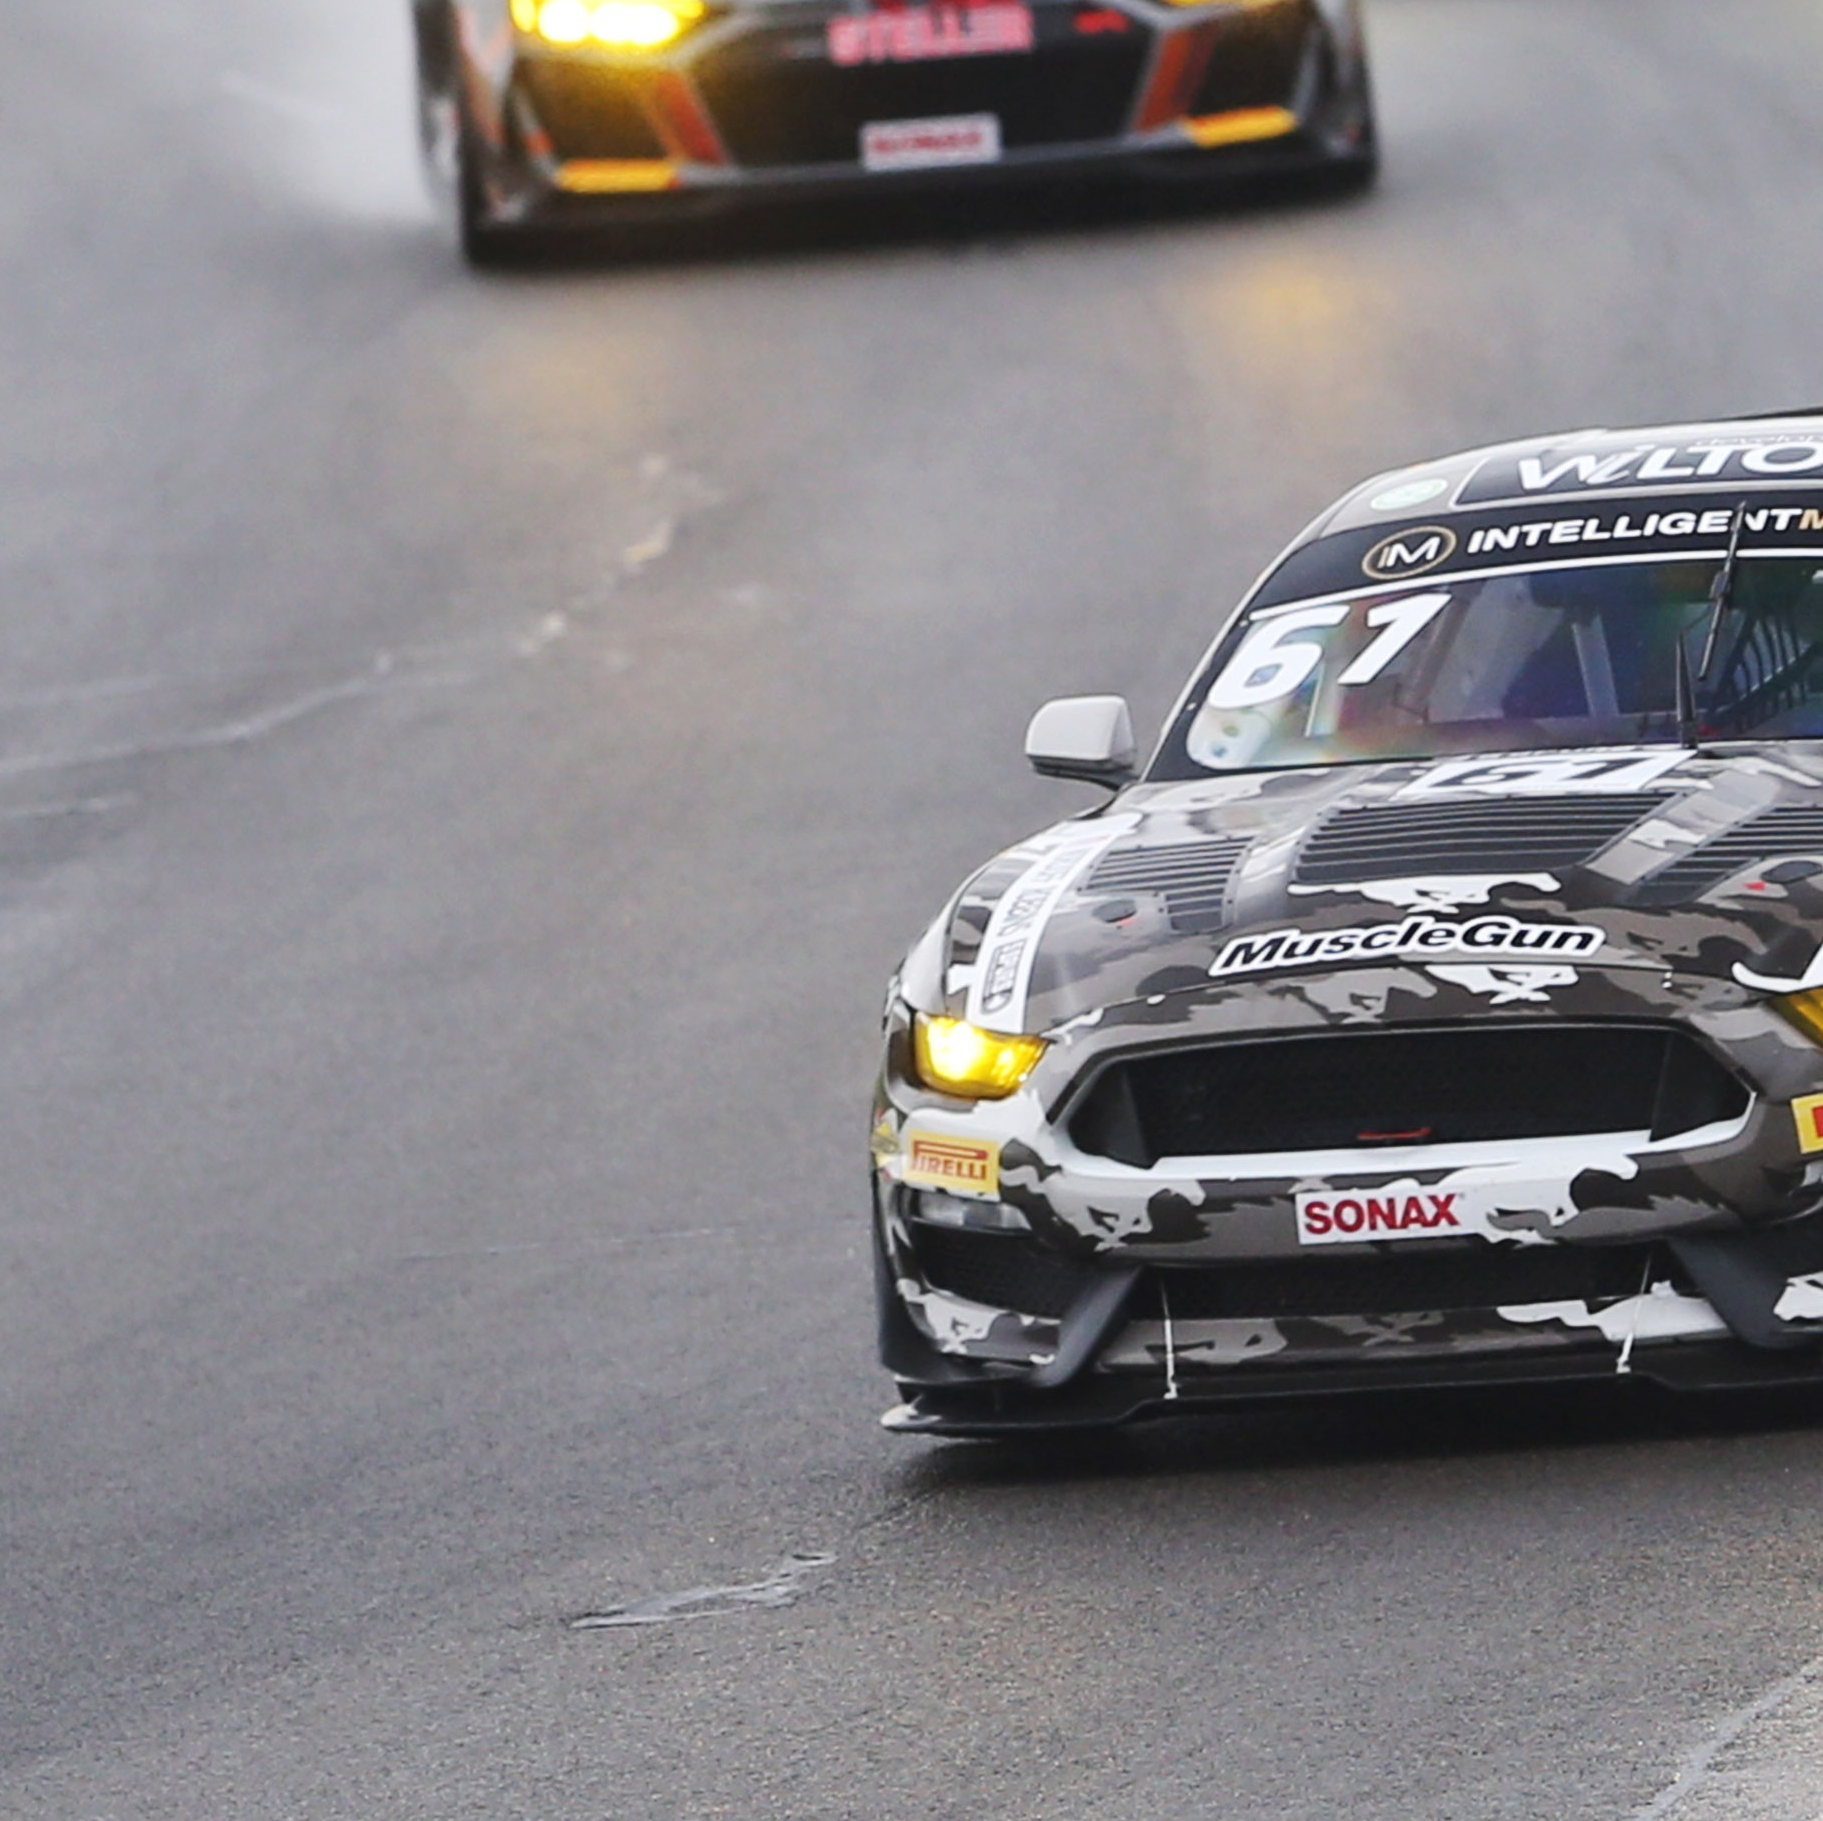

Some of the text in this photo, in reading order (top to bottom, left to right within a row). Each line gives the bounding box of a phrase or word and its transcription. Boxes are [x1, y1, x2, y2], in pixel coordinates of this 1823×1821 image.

[1208, 593, 1452, 709] 61
[1220, 918, 1599, 969] MuscleGun
[912, 1140, 988, 1180] PIRELLI
[1304, 1193, 1460, 1235] SONAX
